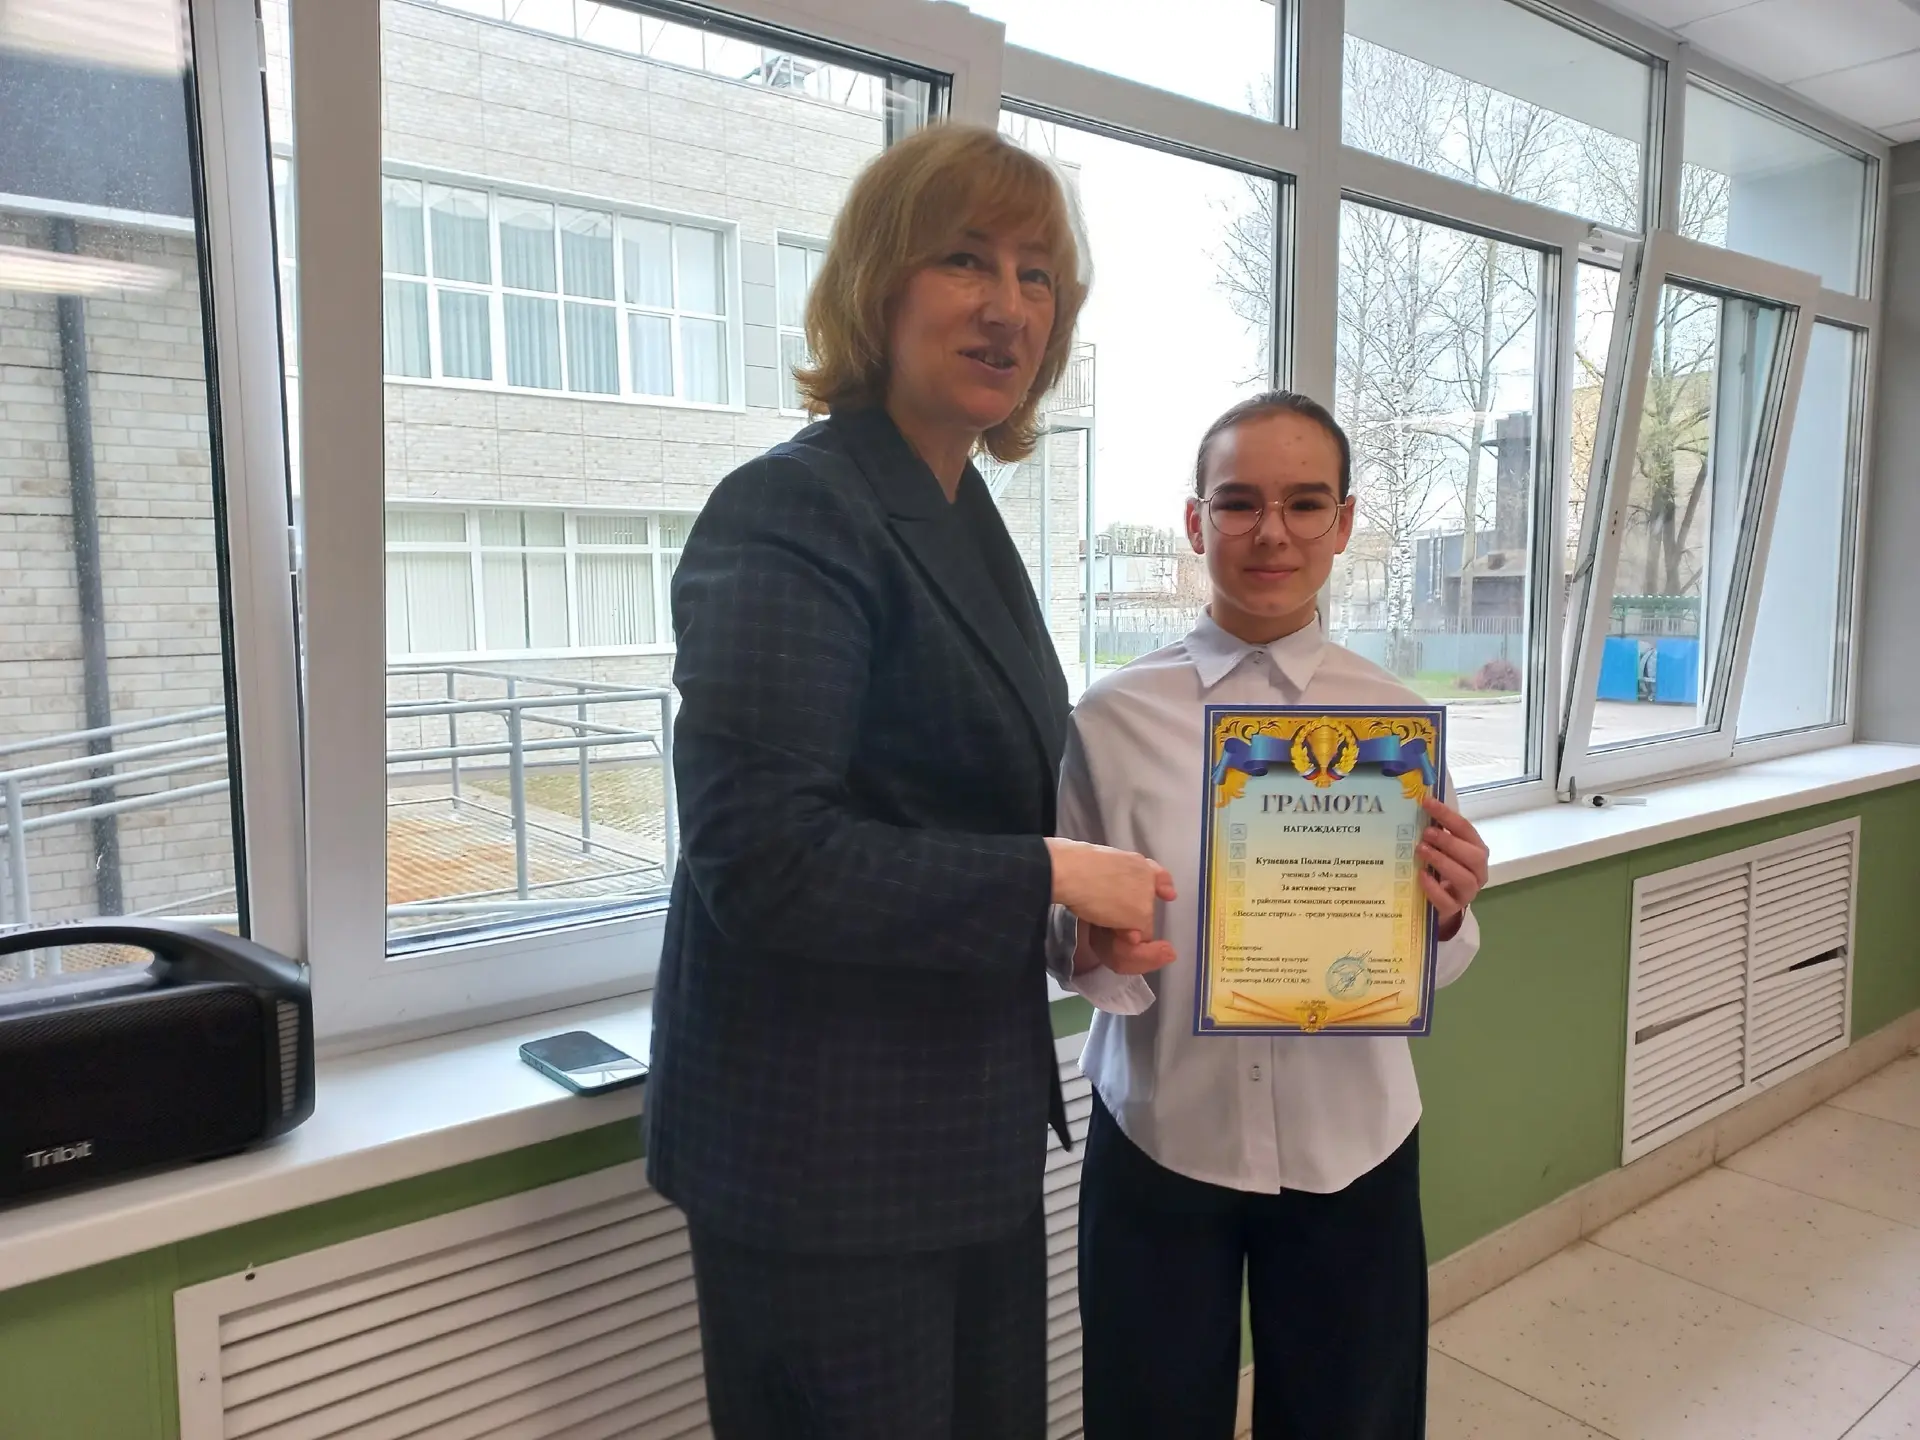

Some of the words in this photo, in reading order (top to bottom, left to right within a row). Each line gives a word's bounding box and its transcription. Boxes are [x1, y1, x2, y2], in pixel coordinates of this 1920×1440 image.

[1260, 794, 1385, 814] ГРАМОТА
[1283, 825, 1361, 833] НАГРАЖДАЕТСЯ
[1300, 857, 1331, 865] Полина
[1333, 857, 1384, 866] Дмитриевна
[1327, 885, 1357, 893] участие
[25, 1141, 92, 1169] Tribit
